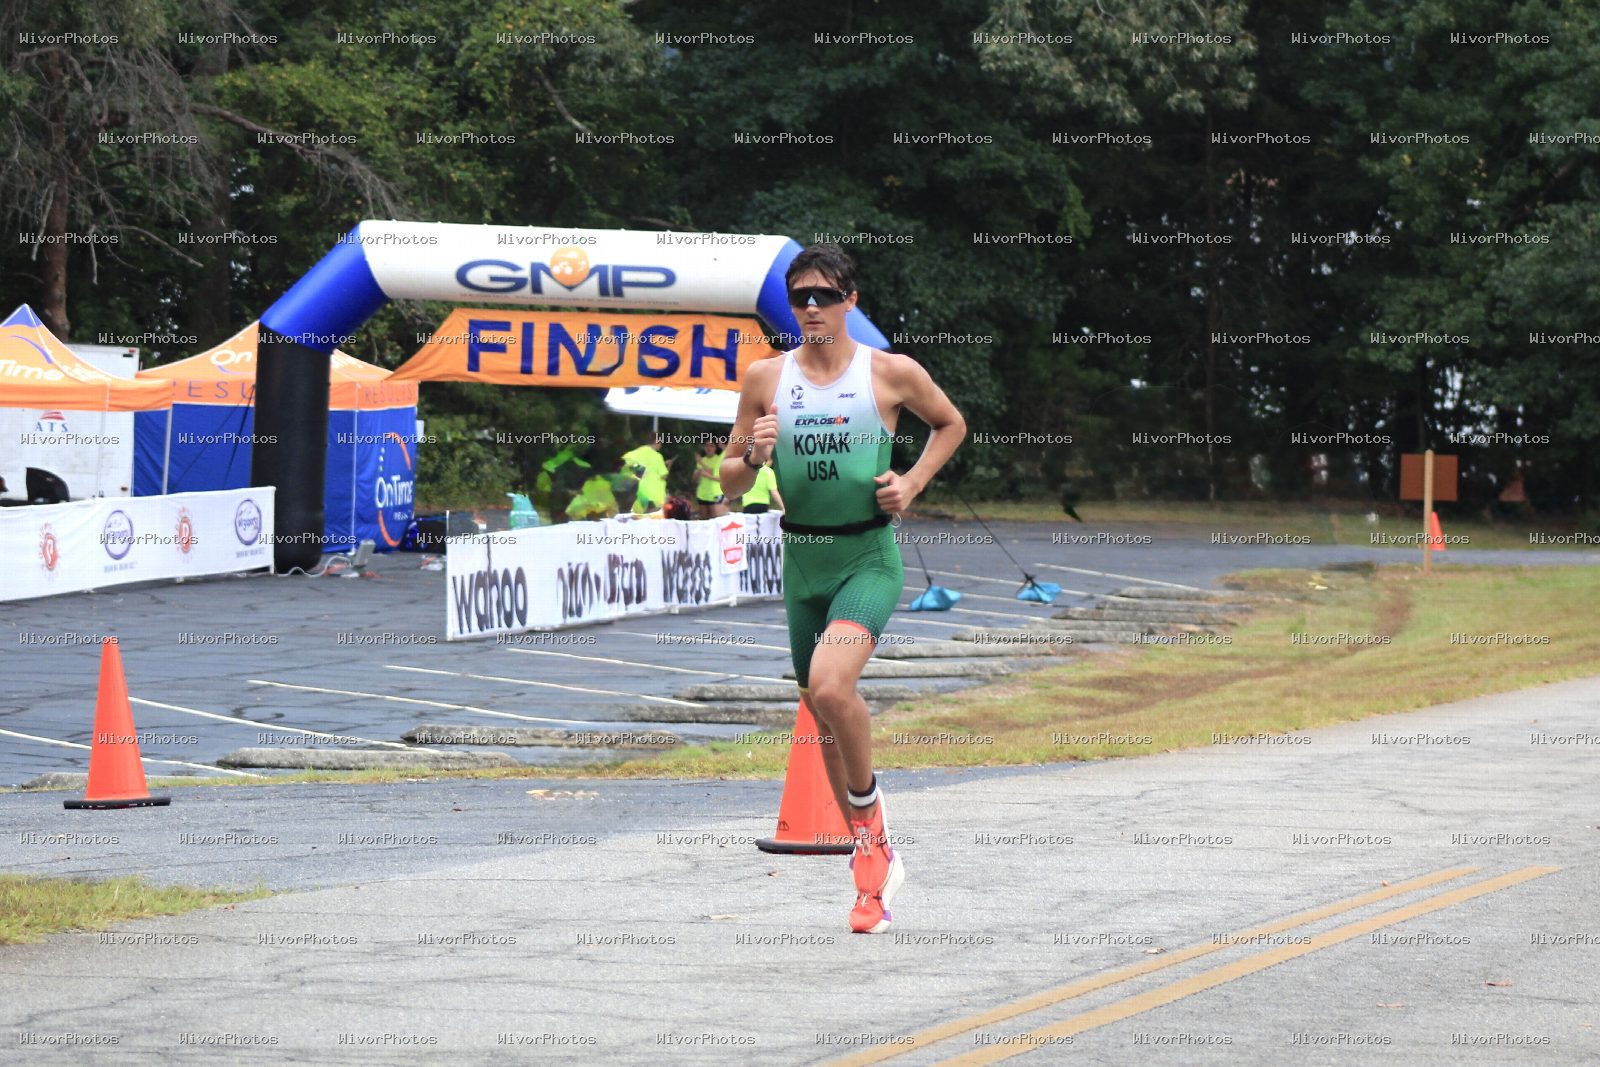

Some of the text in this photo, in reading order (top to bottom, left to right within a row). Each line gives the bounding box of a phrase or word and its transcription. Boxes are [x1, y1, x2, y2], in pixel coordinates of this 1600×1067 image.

[456, 259, 677, 298] GMP
[35, 421, 68, 432] ATS
[793, 432, 851, 456] KOVAK
[807, 459, 840, 482] USA
